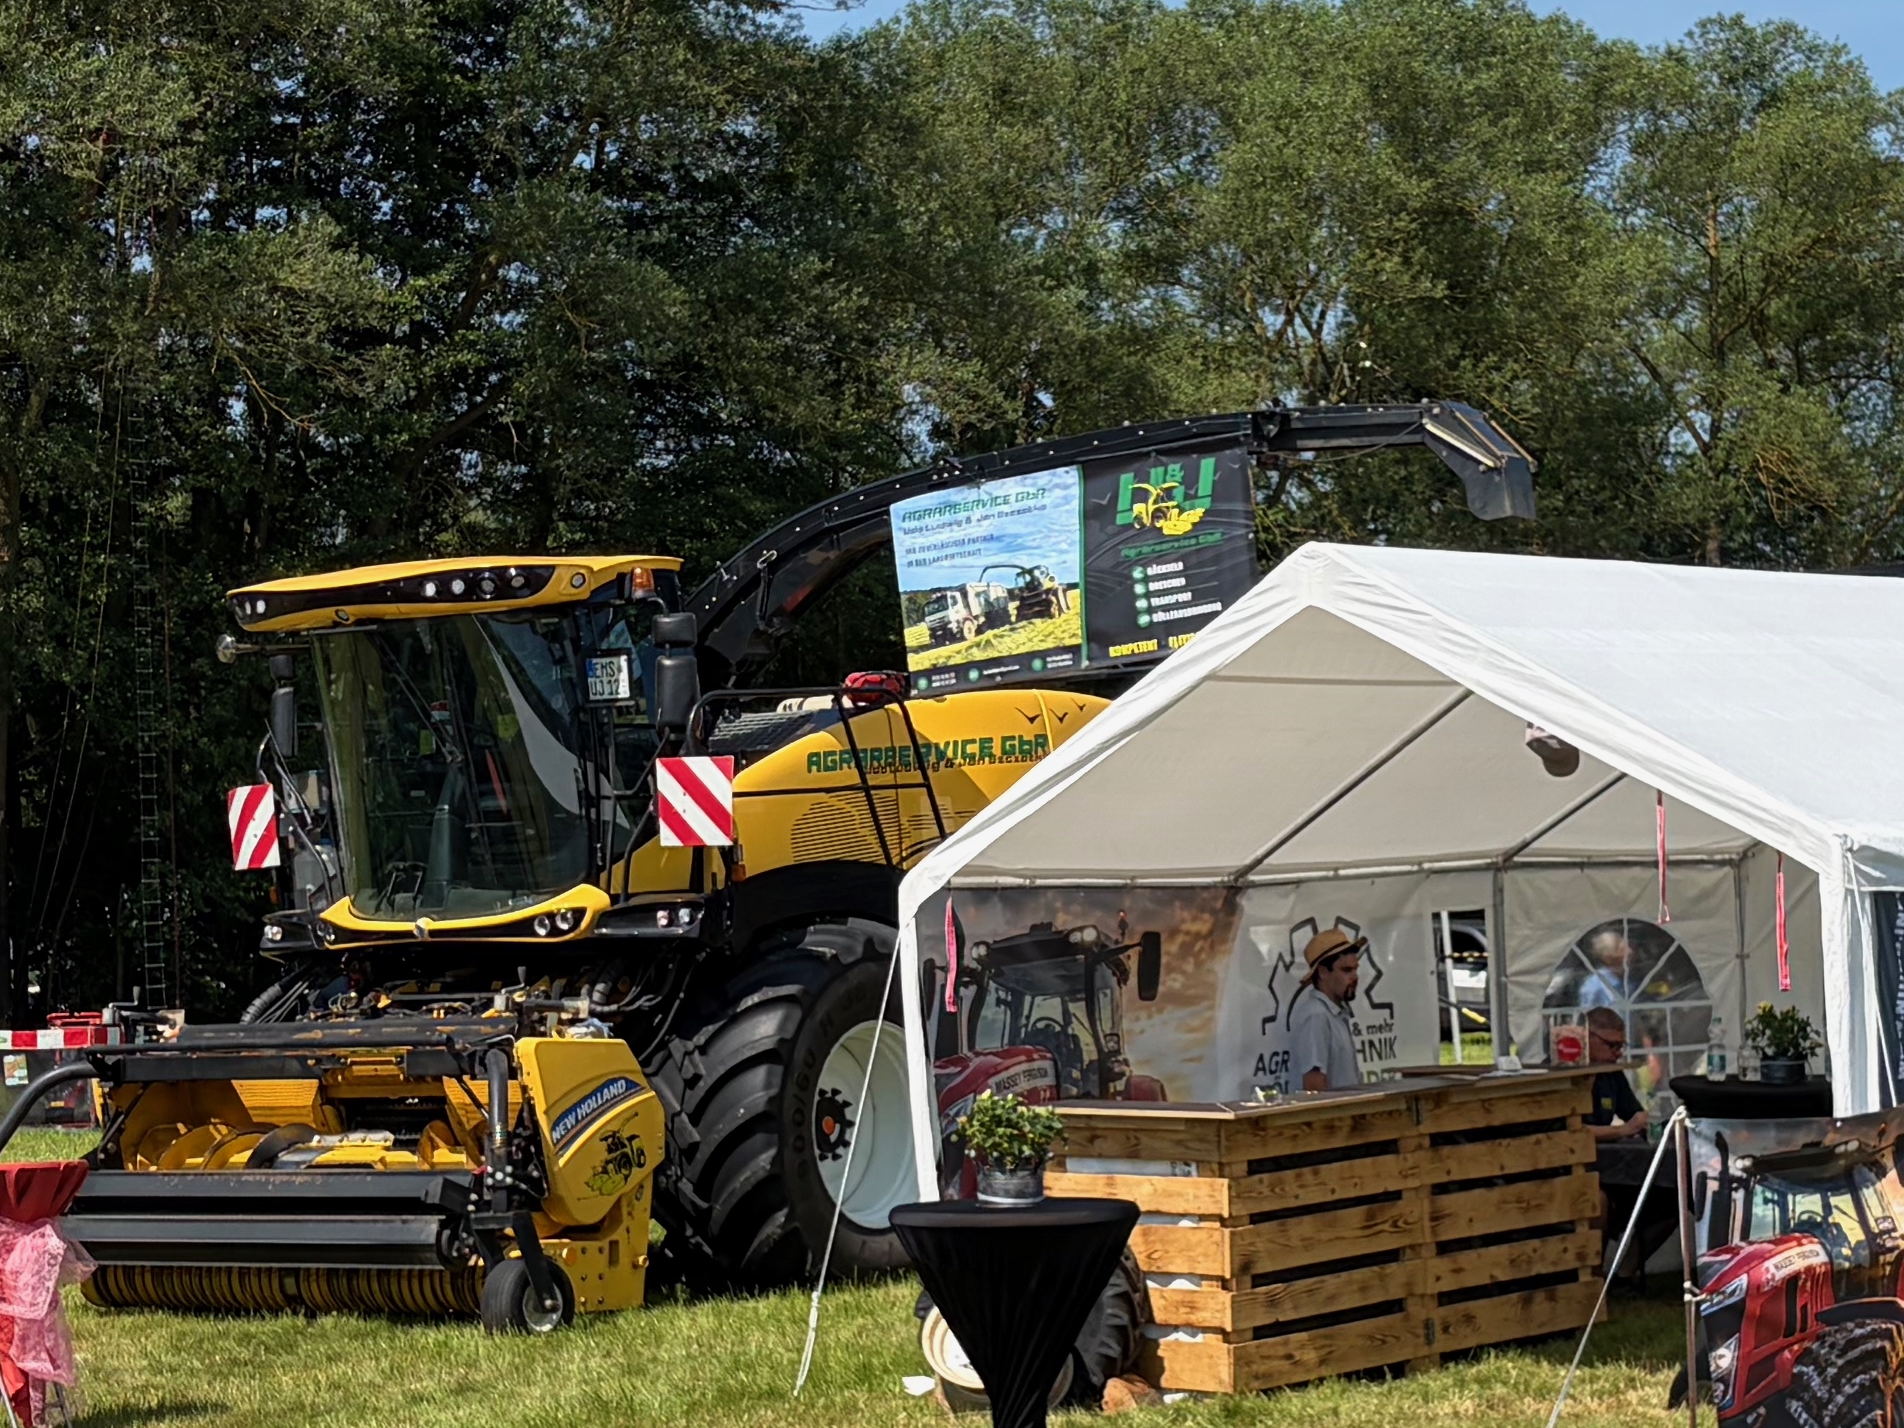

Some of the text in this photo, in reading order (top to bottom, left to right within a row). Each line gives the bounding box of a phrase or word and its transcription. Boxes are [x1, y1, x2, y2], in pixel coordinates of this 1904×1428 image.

[901, 493, 1012, 524] AGRARSERVICE
[595, 660, 616, 679] EMS
[807, 733, 1048, 774] AGRARSERVICE GbR
[1352, 1018, 1395, 1037] & mehr
[551, 1079, 627, 1144] NEW HOLLAND
